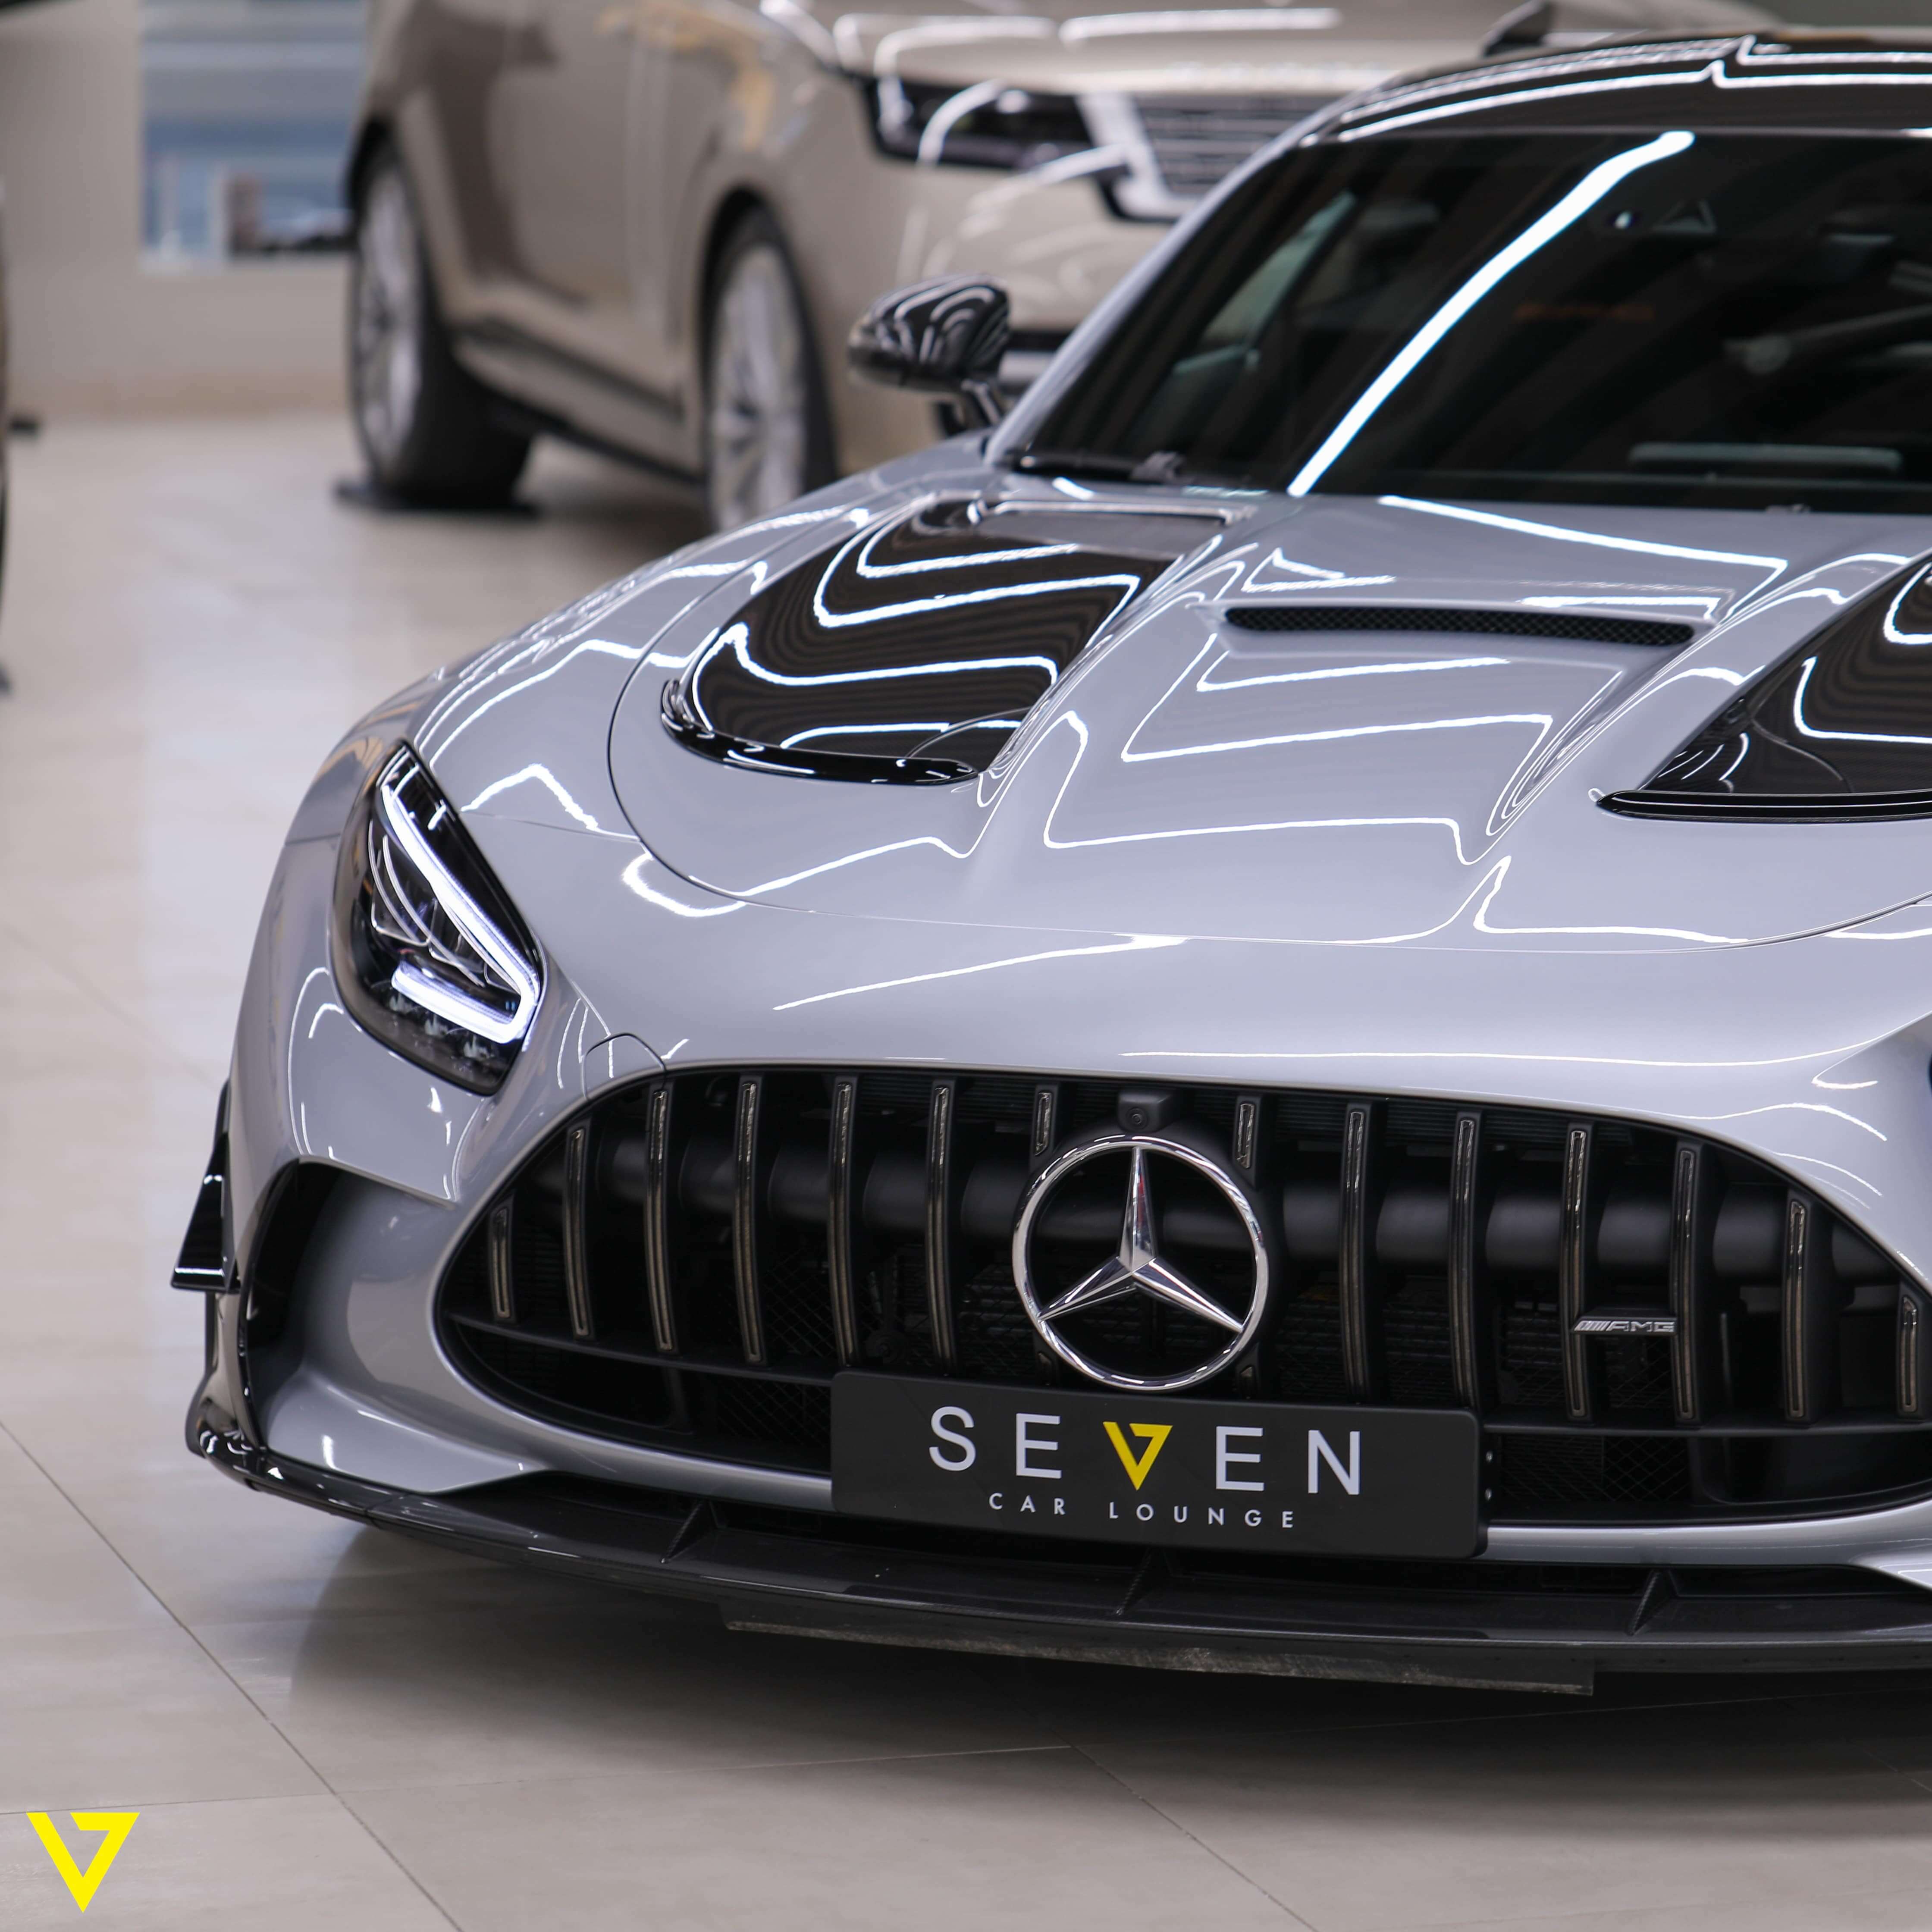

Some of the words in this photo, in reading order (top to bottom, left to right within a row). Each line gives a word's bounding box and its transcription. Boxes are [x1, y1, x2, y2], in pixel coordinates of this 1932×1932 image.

[1606, 1320, 1675, 1332] AMG
[929, 1406, 1360, 1495] SEVEN
[989, 1493, 1065, 1515] CAR
[1109, 1502, 1293, 1528] LOUNGE
